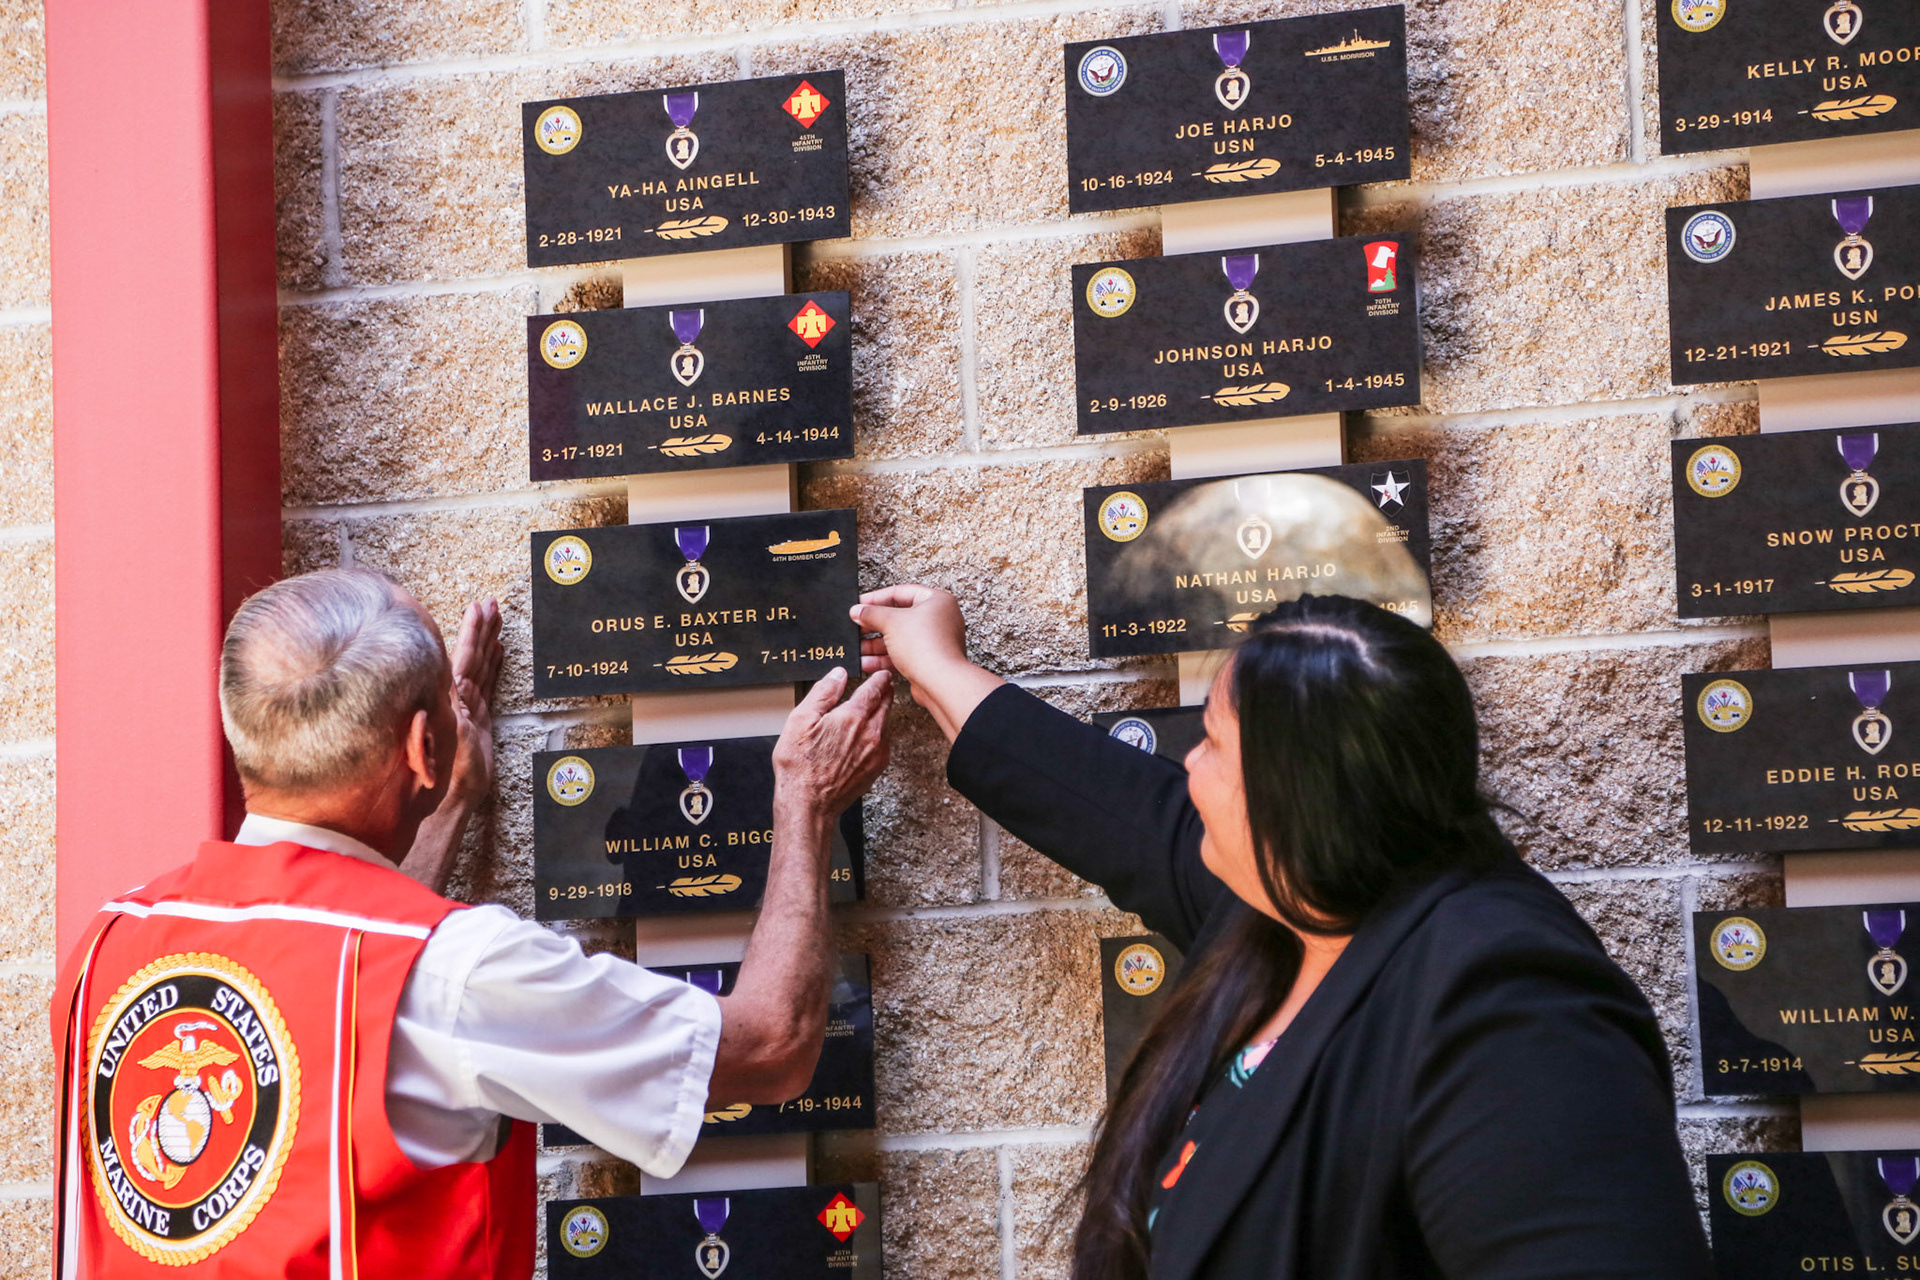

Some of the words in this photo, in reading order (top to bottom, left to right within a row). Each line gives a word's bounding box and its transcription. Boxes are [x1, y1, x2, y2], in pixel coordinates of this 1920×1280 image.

[1748, 59, 1816, 79] KELLY
[1827, 56, 1848, 70] R.
[1823, 74, 1868, 91] USA
[1176, 123, 1214, 139] JOE
[1224, 114, 1292, 133] HARJO
[1675, 109, 1773, 132] 3-29-1914
[792, 138, 823, 146] INFANTRY
[793, 144, 822, 152] DIVISION
[1214, 139, 1255, 155] USN
[1315, 147, 1395, 167] 5-4-1945
[608, 181, 667, 198] YA-HA
[676, 172, 759, 192] AINGELL
[1081, 170, 1173, 192] 10-16-1924
[666, 197, 703, 212] USA
[743, 206, 835, 227] 12-30-1943
[539, 228, 622, 247] 2-28-1921
[1367, 303, 1400, 311] INFANTRY
[1765, 292, 1841, 311] JAMES
[1852, 290, 1873, 303] K.
[1885, 286, 1920, 301] PO
[1833, 310, 1878, 326] USN
[1154, 343, 1253, 365] JOHNSON
[1263, 336, 1332, 355] HARJO
[1685, 341, 1791, 362] 12-21-1921
[797, 358, 828, 366] INFANTRY
[799, 364, 827, 372] DIVISION
[1224, 363, 1264, 378] USA
[1325, 374, 1405, 392] 1-4-1945
[586, 397, 678, 416] WALLACE
[687, 396, 702, 408] J.
[712, 388, 791, 406] BARNES
[1091, 395, 1167, 412] 2-9-1926
[669, 414, 708, 429] USA
[756, 427, 839, 445] 4-14-1944
[542, 444, 623, 461] 3-17-1921
[1378, 536, 1409, 544] DIVISION
[1767, 529, 1834, 547] SNOW
[789, 554, 814, 562] BOMBER
[815, 552, 837, 560] GROUP
[1840, 548, 1885, 563] USA
[1176, 570, 1257, 589] NATHAN
[1267, 564, 1337, 581] HARJO
[1237, 589, 1277, 604] USA
[1691, 579, 1774, 597] 3-1-1917
[591, 617, 645, 633] ORUS
[654, 615, 671, 628] E.
[681, 609, 757, 627] BAXTER
[767, 606, 797, 621] JR.
[1102, 619, 1186, 637] 11-3-1922
[675, 632, 713, 647] USA
[761, 646, 845, 664] 7-11-1944
[547, 662, 628, 678] 7-10-1924
[1767, 768, 1835, 784] EDDIE
[1847, 766, 1866, 780] H.
[1853, 787, 1899, 801] USA
[1703, 816, 1809, 833] 12-11-1922
[606, 835, 690, 853] WILLIAM
[699, 834, 717, 847] C.
[678, 855, 717, 868] USA
[549, 883, 632, 900] 9-29-1918
[1780, 1007, 1879, 1024] WILLIAM
[1890, 1007, 1914, 1020] W.
[99, 985, 178, 1079] UNITED
[211, 986, 279, 1087] STATES
[826, 1024, 856, 1032] NFANTRY
[1869, 1029, 1915, 1043] USA
[1718, 1058, 1803, 1073] 3-7-1914
[100, 1137, 169, 1236] MARINE
[192, 1144, 266, 1231] CORPS
[1801, 1256, 1855, 1272] OTIS
[1866, 1257, 1884, 1271] L.
